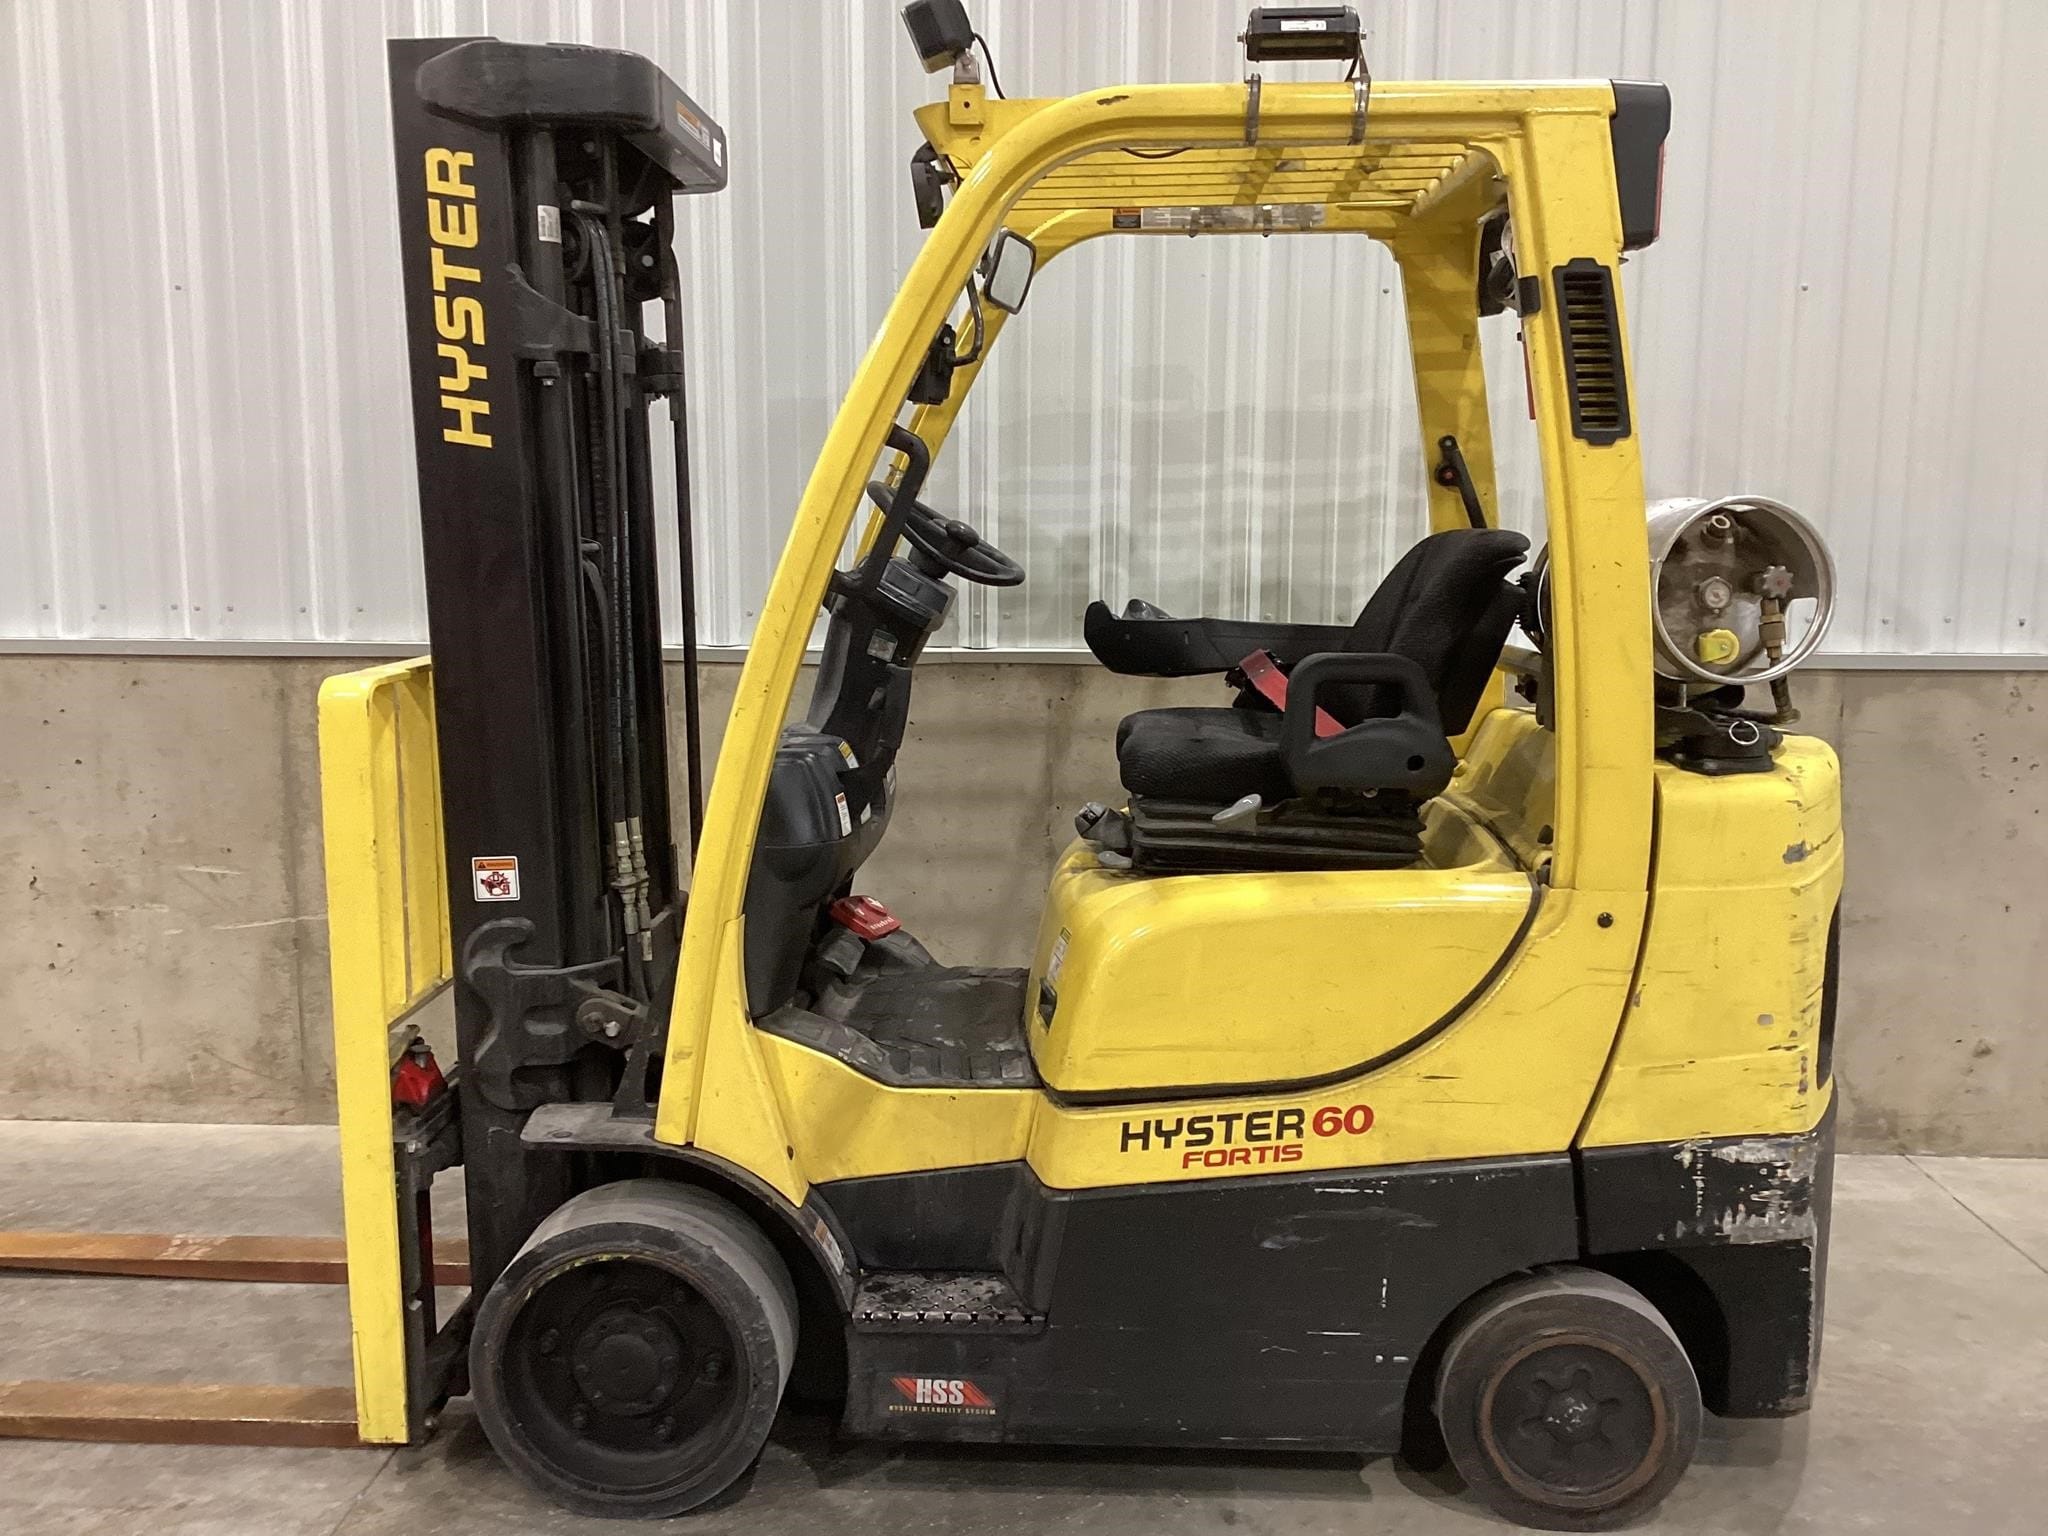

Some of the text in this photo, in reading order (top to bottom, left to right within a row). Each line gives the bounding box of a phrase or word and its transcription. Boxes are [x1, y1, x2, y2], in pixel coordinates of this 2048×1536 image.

[425, 147, 493, 449] HYSTER
[1120, 1104, 1374, 1153] HYSTER 60
[1182, 1144, 1304, 1169] FORTIS
[916, 1378, 965, 1405] HSS
